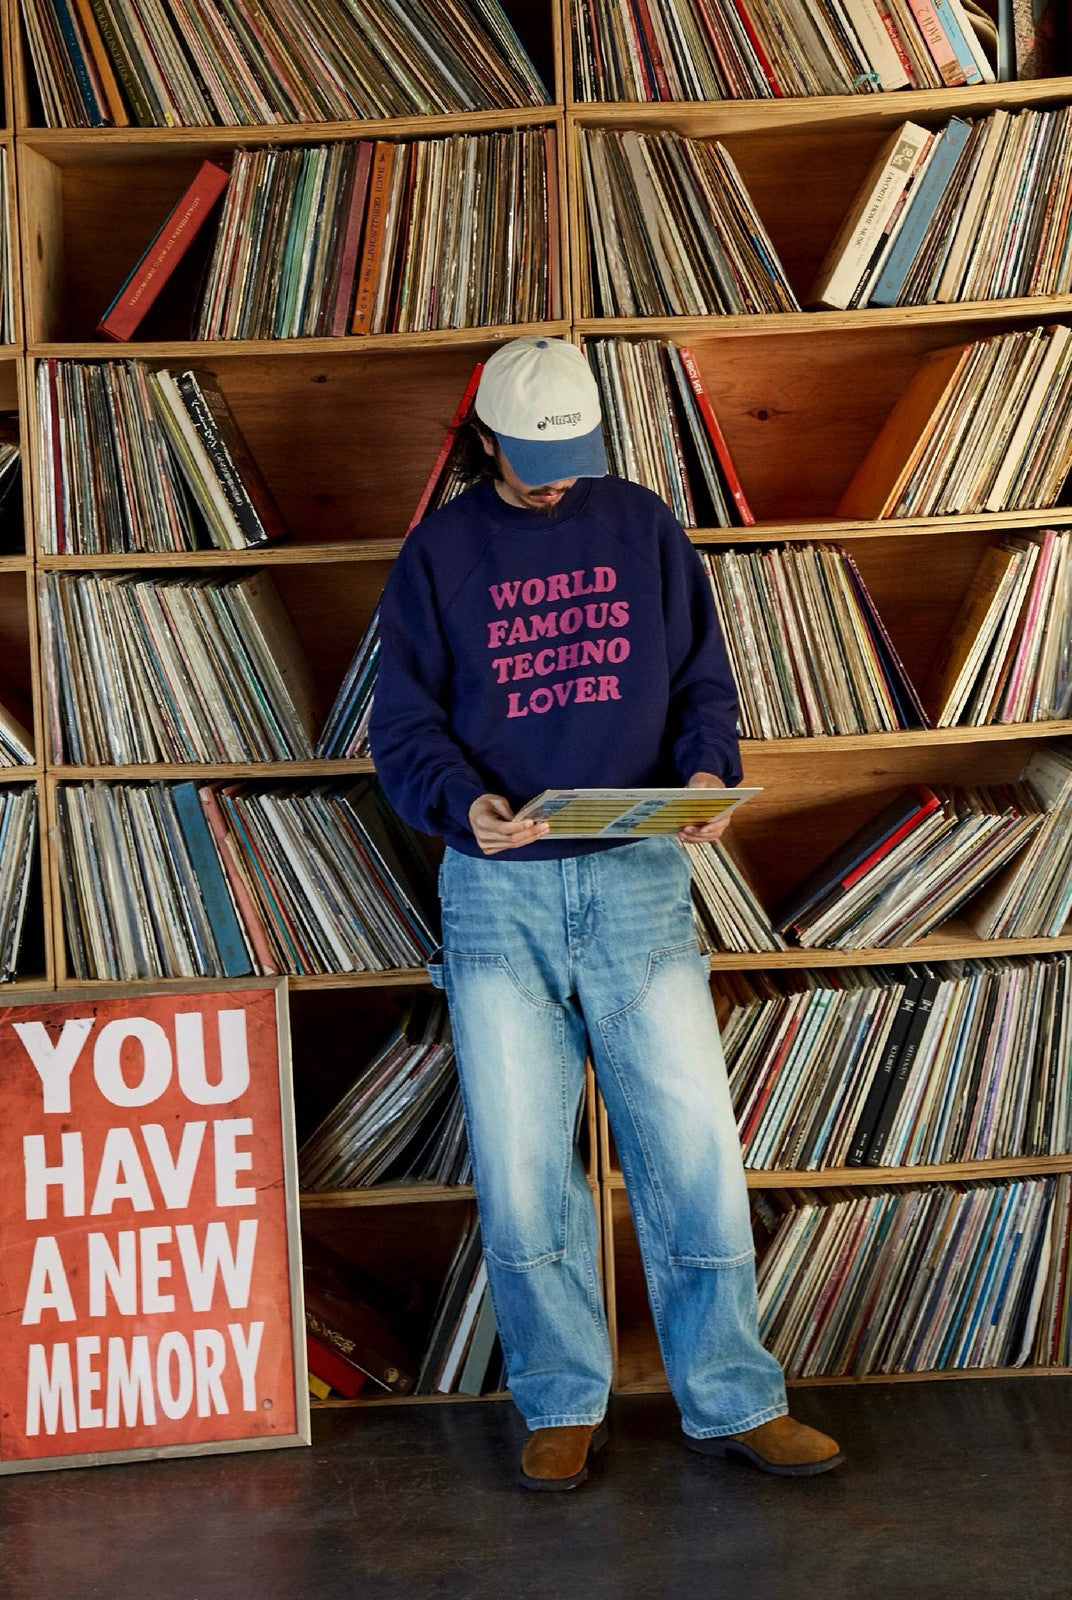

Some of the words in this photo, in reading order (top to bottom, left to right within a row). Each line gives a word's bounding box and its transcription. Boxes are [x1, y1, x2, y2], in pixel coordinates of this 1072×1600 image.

[917, 6, 928, 16] 2
[920, 16, 942, 44] BACH
[375, 166, 384, 192] BACH
[877, 173, 893, 202] FAVORITE
[866, 204, 878, 224] HOME
[855, 228, 867, 247] MUSIC
[685, 359, 697, 380] PERCY
[488, 566, 617, 610] WORLD
[487, 601, 630, 648] FAMOUS
[492, 637, 631, 684] TECHNO
[506, 676, 621, 719] LOVER
[12, 1009, 250, 1114] YOU
[23, 1117, 257, 1220] HAVE
[21, 1236, 77, 1326] A
[88, 1219, 258, 1317] NEW
[25, 1321, 264, 1436] MEMORY
